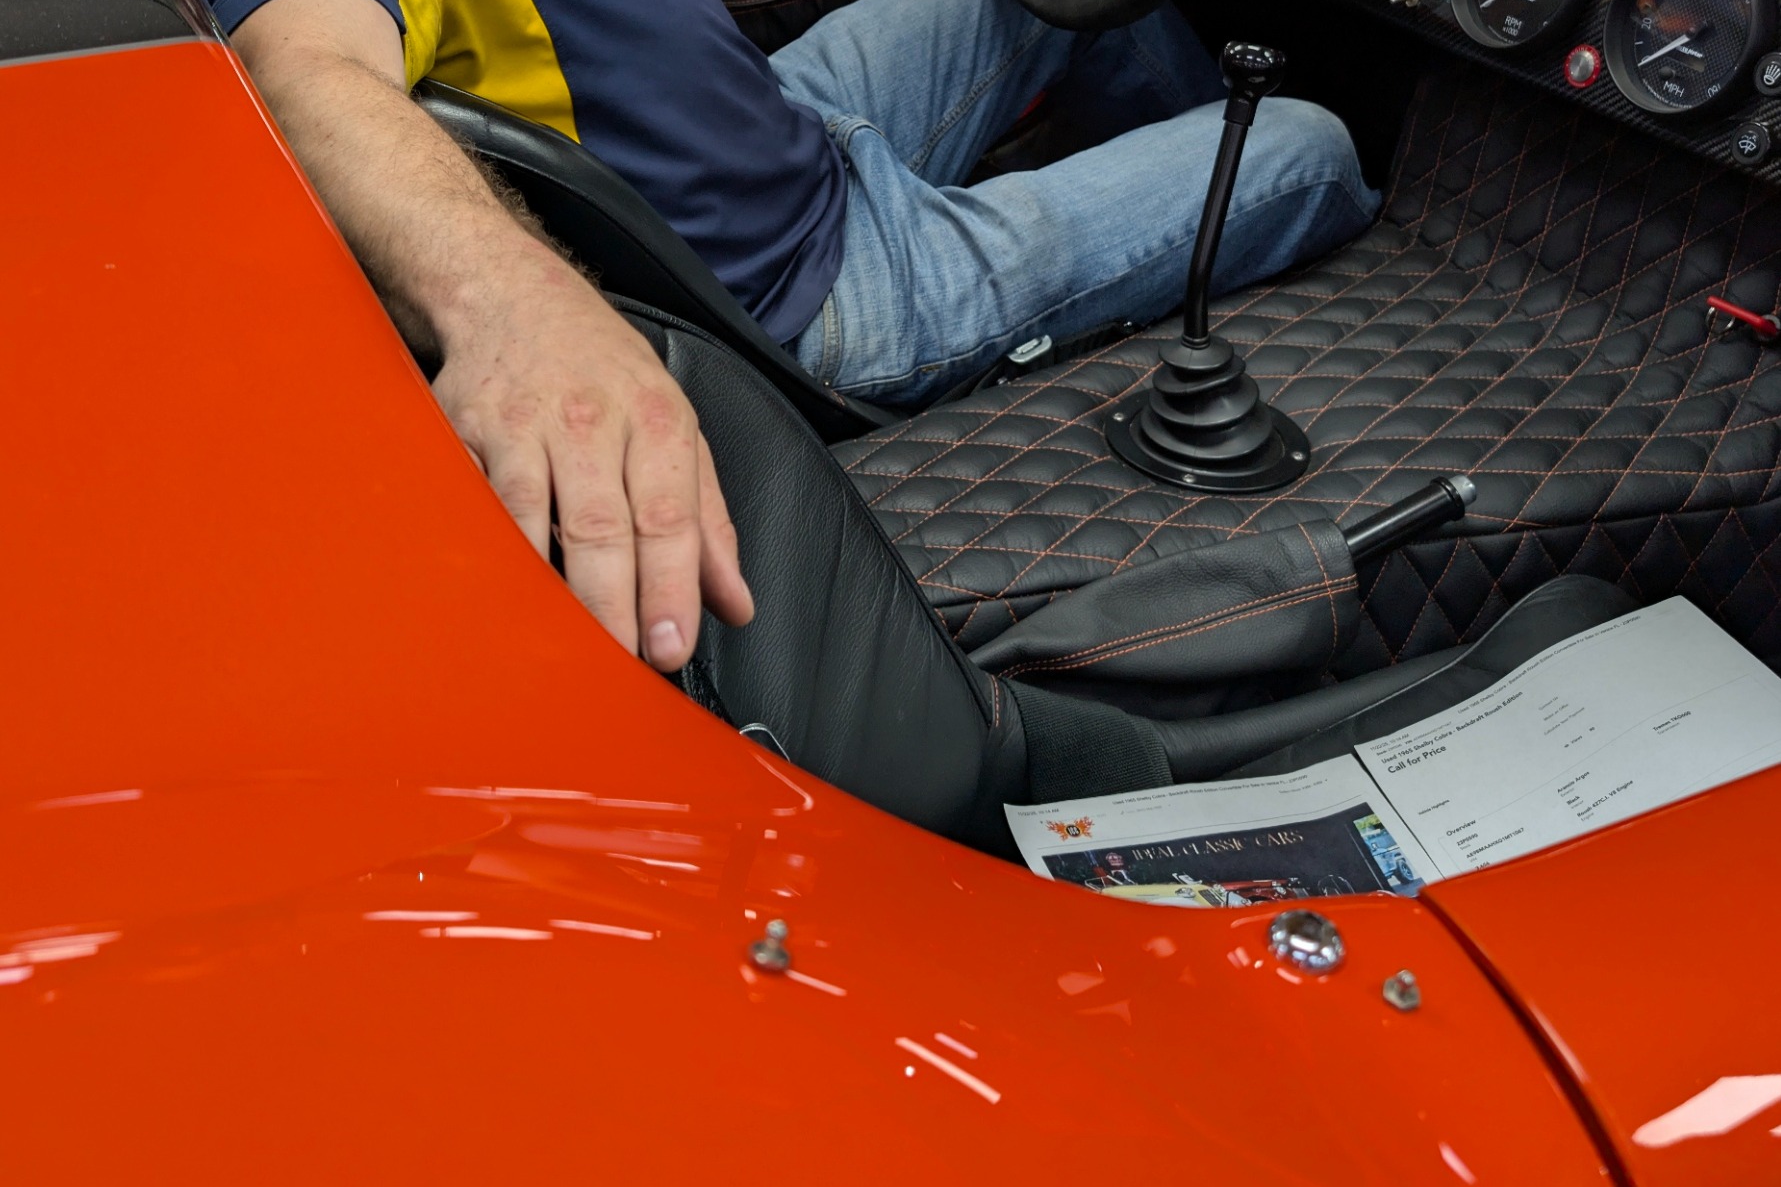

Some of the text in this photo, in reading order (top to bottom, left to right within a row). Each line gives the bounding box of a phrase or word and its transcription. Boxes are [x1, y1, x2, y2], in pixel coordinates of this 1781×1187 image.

[1504, 15, 1522, 30] RPM
[1641, 17, 1653, 30] 20
[1663, 81, 1684, 98] MPH
[1381, 754, 1398, 764] Used
[1398, 748, 1413, 758] 1965
[1414, 739, 1434, 750] Shelby
[1434, 731, 1452, 742] Cobra
[1456, 714, 1484, 731] Backdraft
[1484, 705, 1502, 717] Roush
[1502, 692, 1523, 706] Edition
[1388, 746, 1447, 774] Call for Price
[1446, 820, 1476, 836] Overview
[1132, 830, 1304, 860] IDEAL CLASSIC CARS
